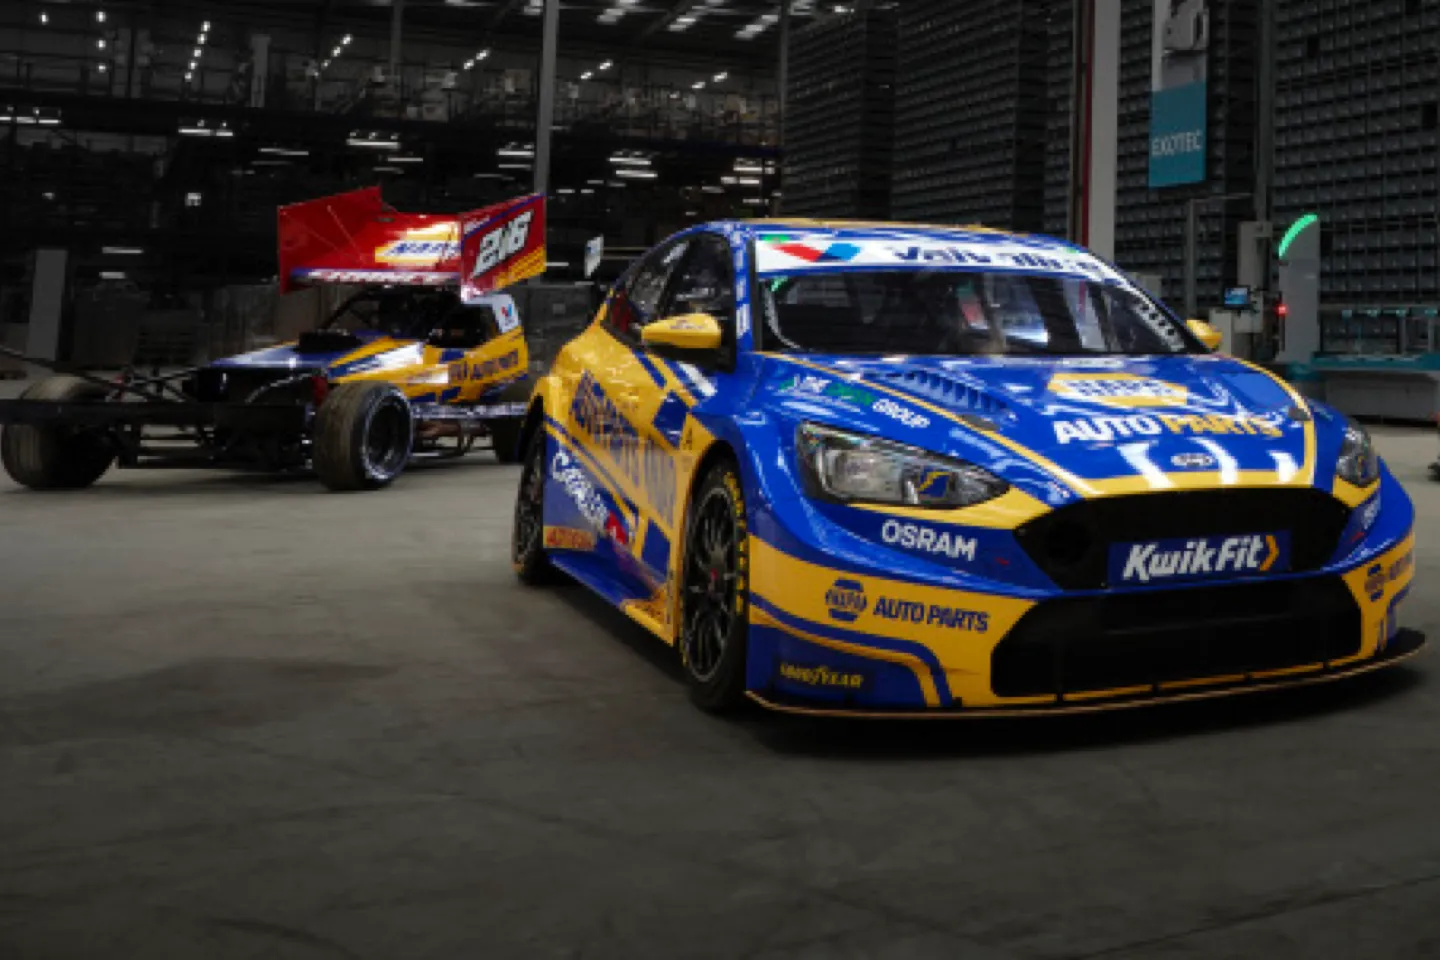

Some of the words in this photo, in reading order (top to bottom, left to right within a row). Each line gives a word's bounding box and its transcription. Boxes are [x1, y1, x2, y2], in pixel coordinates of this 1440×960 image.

[1053, 416, 1162, 444] AUTO
[1157, 415, 1283, 438] PARTS
[882, 519, 978, 561] OSRAM
[873, 596, 924, 623] AUTO
[927, 604, 990, 633] PARTS
